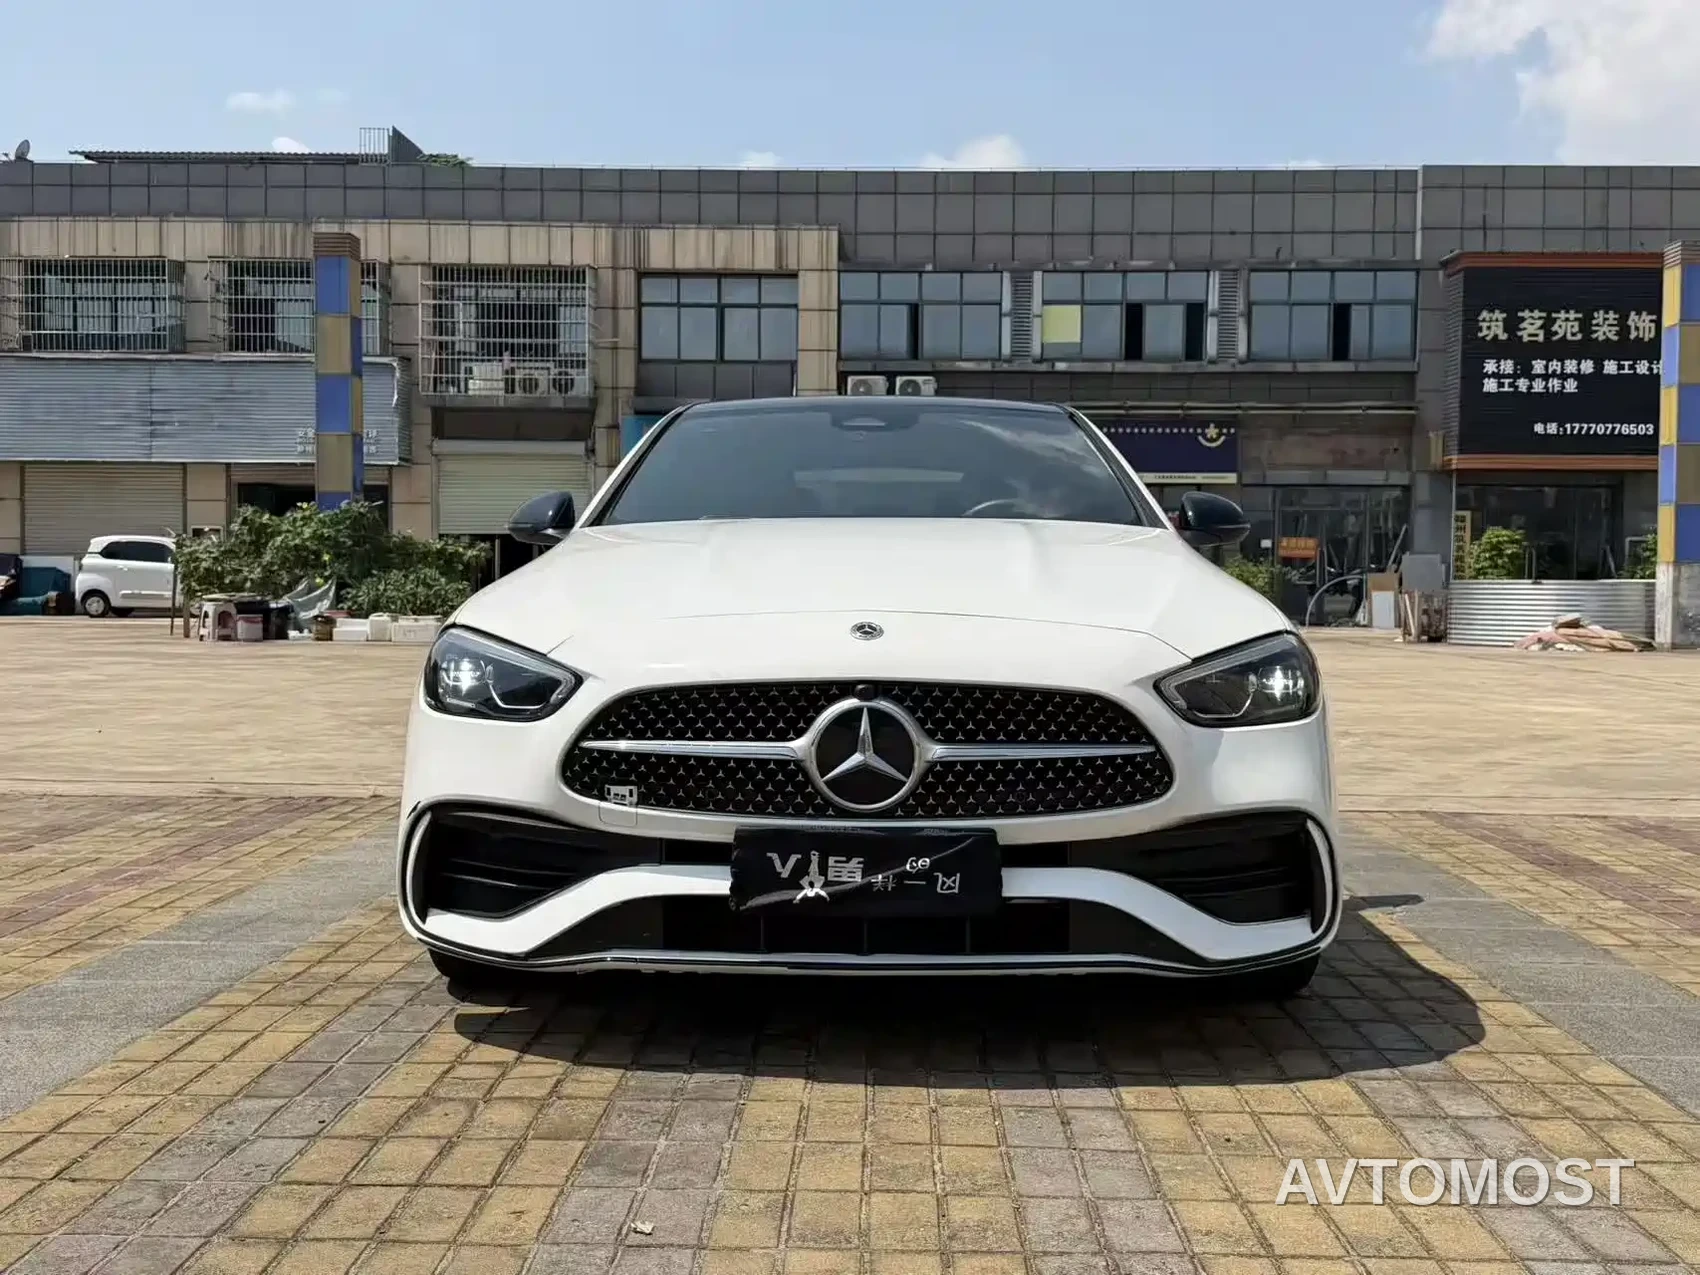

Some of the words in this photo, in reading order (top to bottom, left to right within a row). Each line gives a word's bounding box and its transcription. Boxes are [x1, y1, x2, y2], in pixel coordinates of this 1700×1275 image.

[1477, 309, 1658, 343] 筑茗苑装饰
[1531, 359, 1595, 375] 室内装修
[1482, 378, 1578, 393] 施工专业作业
